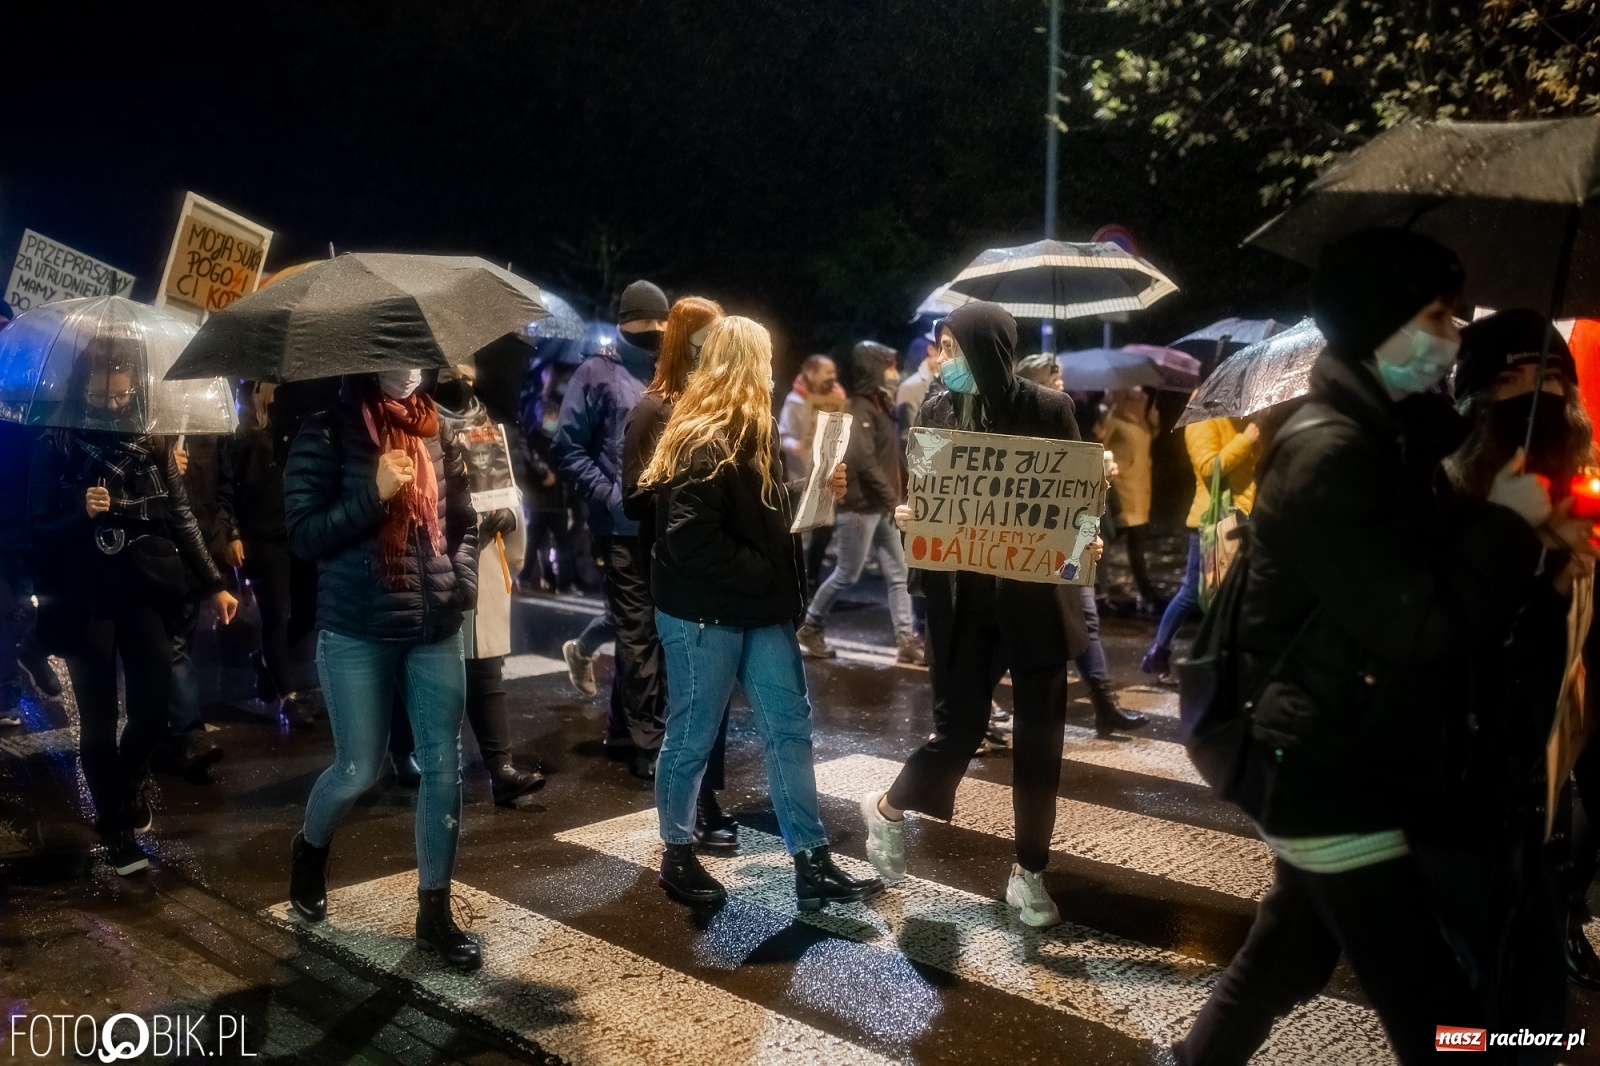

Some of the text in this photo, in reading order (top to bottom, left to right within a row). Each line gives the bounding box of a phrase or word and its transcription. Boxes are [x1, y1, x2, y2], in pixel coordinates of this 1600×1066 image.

[188, 224, 234, 260] MOJA
[15, 254, 112, 297] ZA UTRUDNIENI
[17, 275, 57, 300] MAMY
[177, 274, 198, 298] CI
[11, 292, 30, 310] DO
[950, 446, 1068, 474] FERB JUŻ
[964, 527, 1038, 545] IDZIEMY
